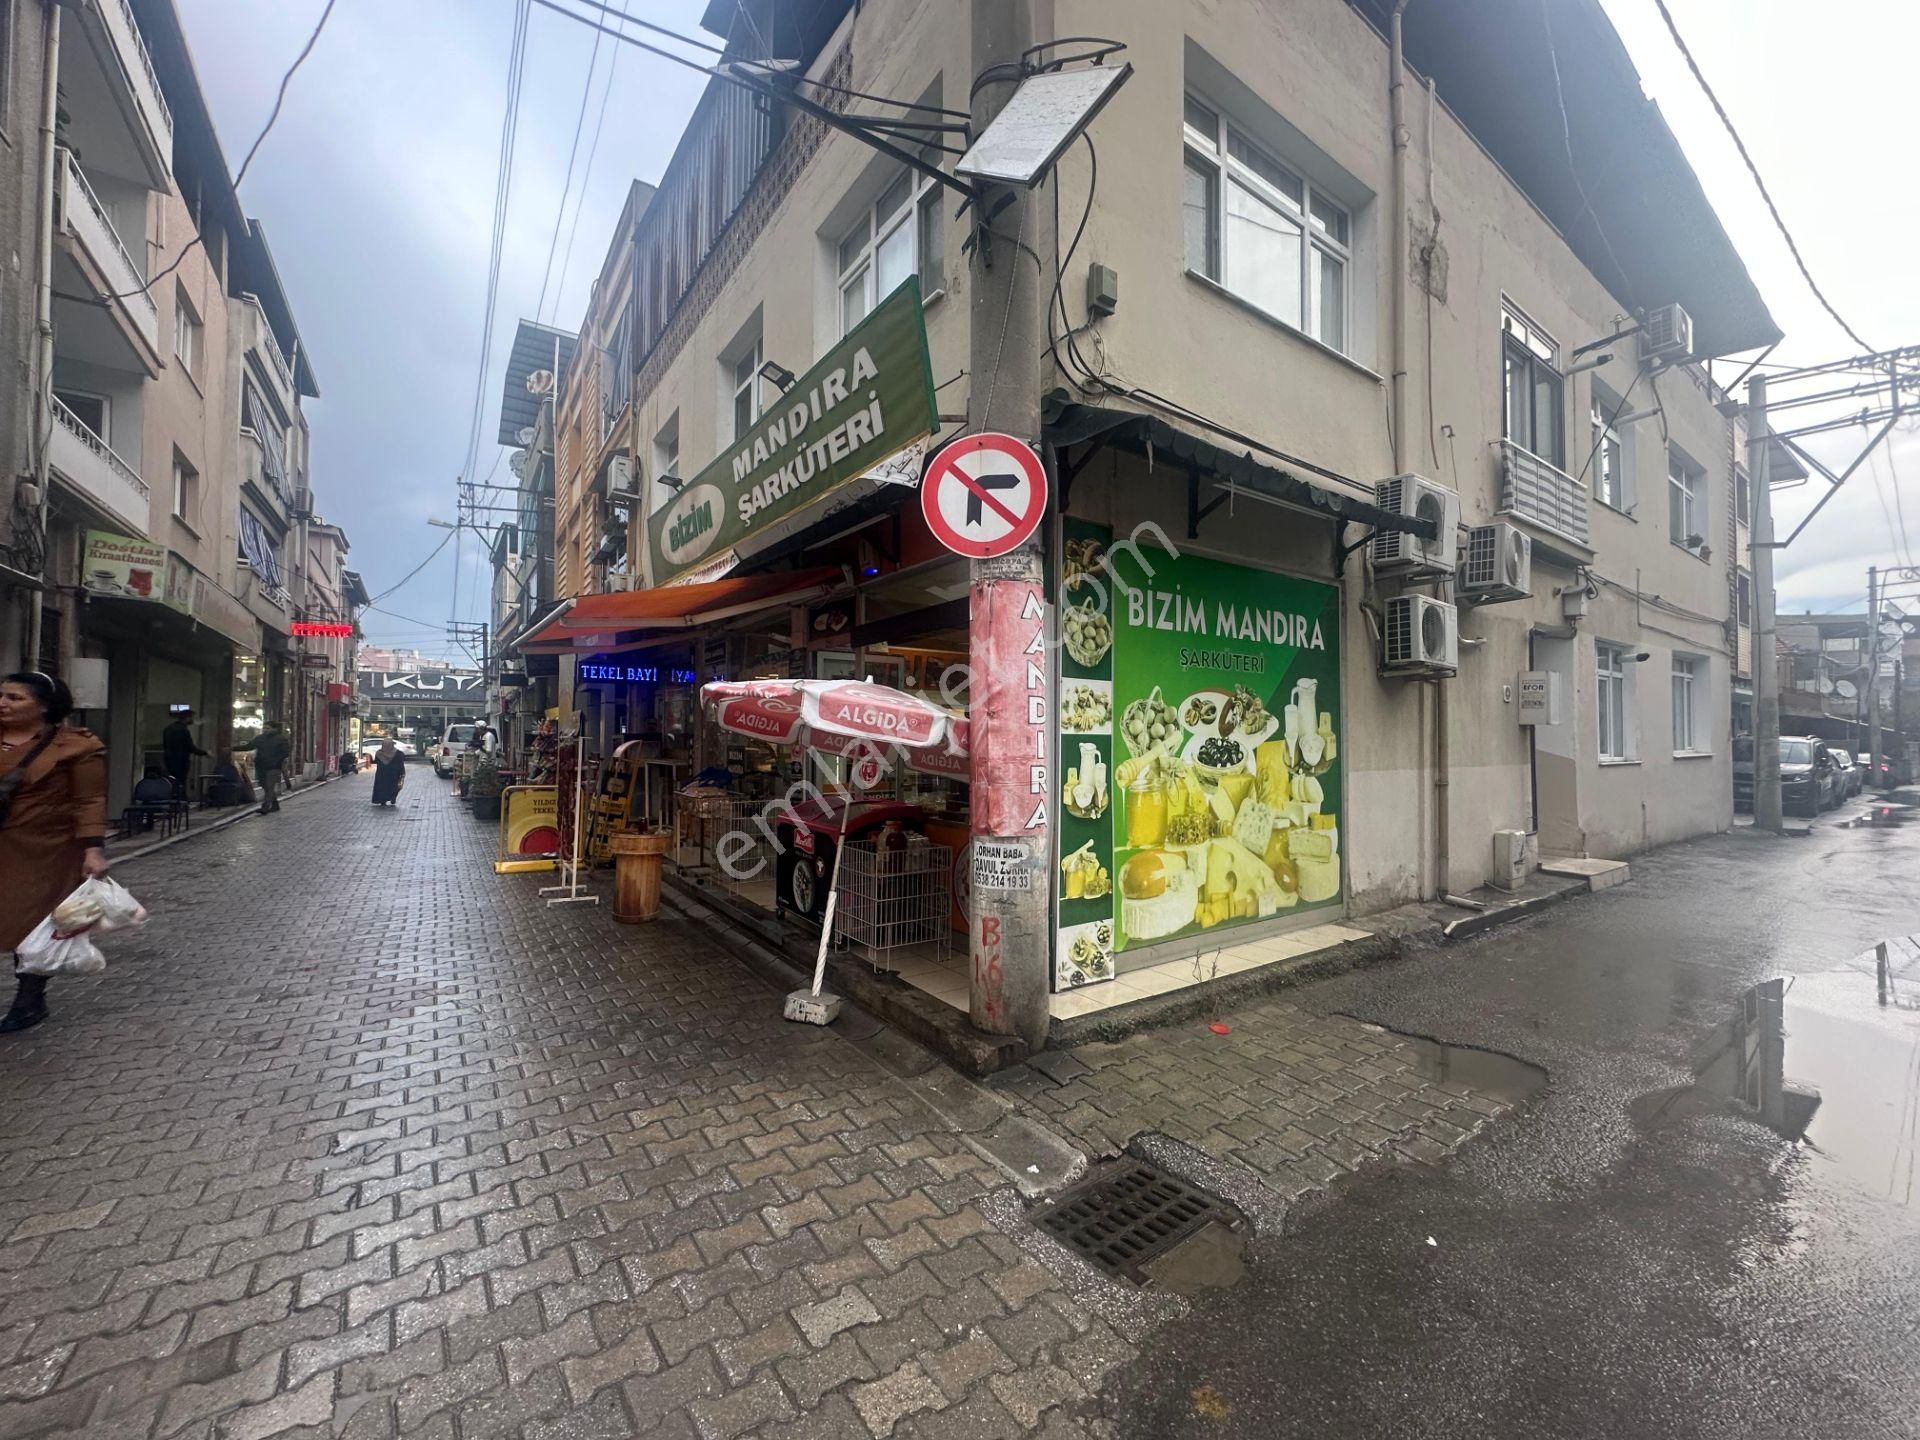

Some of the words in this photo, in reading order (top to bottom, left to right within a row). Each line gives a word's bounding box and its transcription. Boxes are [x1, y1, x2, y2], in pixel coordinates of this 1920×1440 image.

[731, 346, 879, 484] MANDIRA
[738, 389, 884, 528] ŞARKÜTERİ
[668, 499, 713, 552] BİZİM
[93, 539, 165, 558] Dostlar
[1128, 579, 1207, 635] BİZİM
[1216, 602, 1325, 651] MANDIRA
[1179, 647, 1264, 673] ŞARKÜTERİ
[581, 665, 624, 680] TEKEL
[627, 667, 657, 681] BAYİ
[1003, 848, 1023, 859] BABA
[975, 858, 998, 874] DAVUL
[991, 875, 1005, 887] 214
[1008, 876, 1017, 888] 19
[1019, 876, 1029, 888] 33
